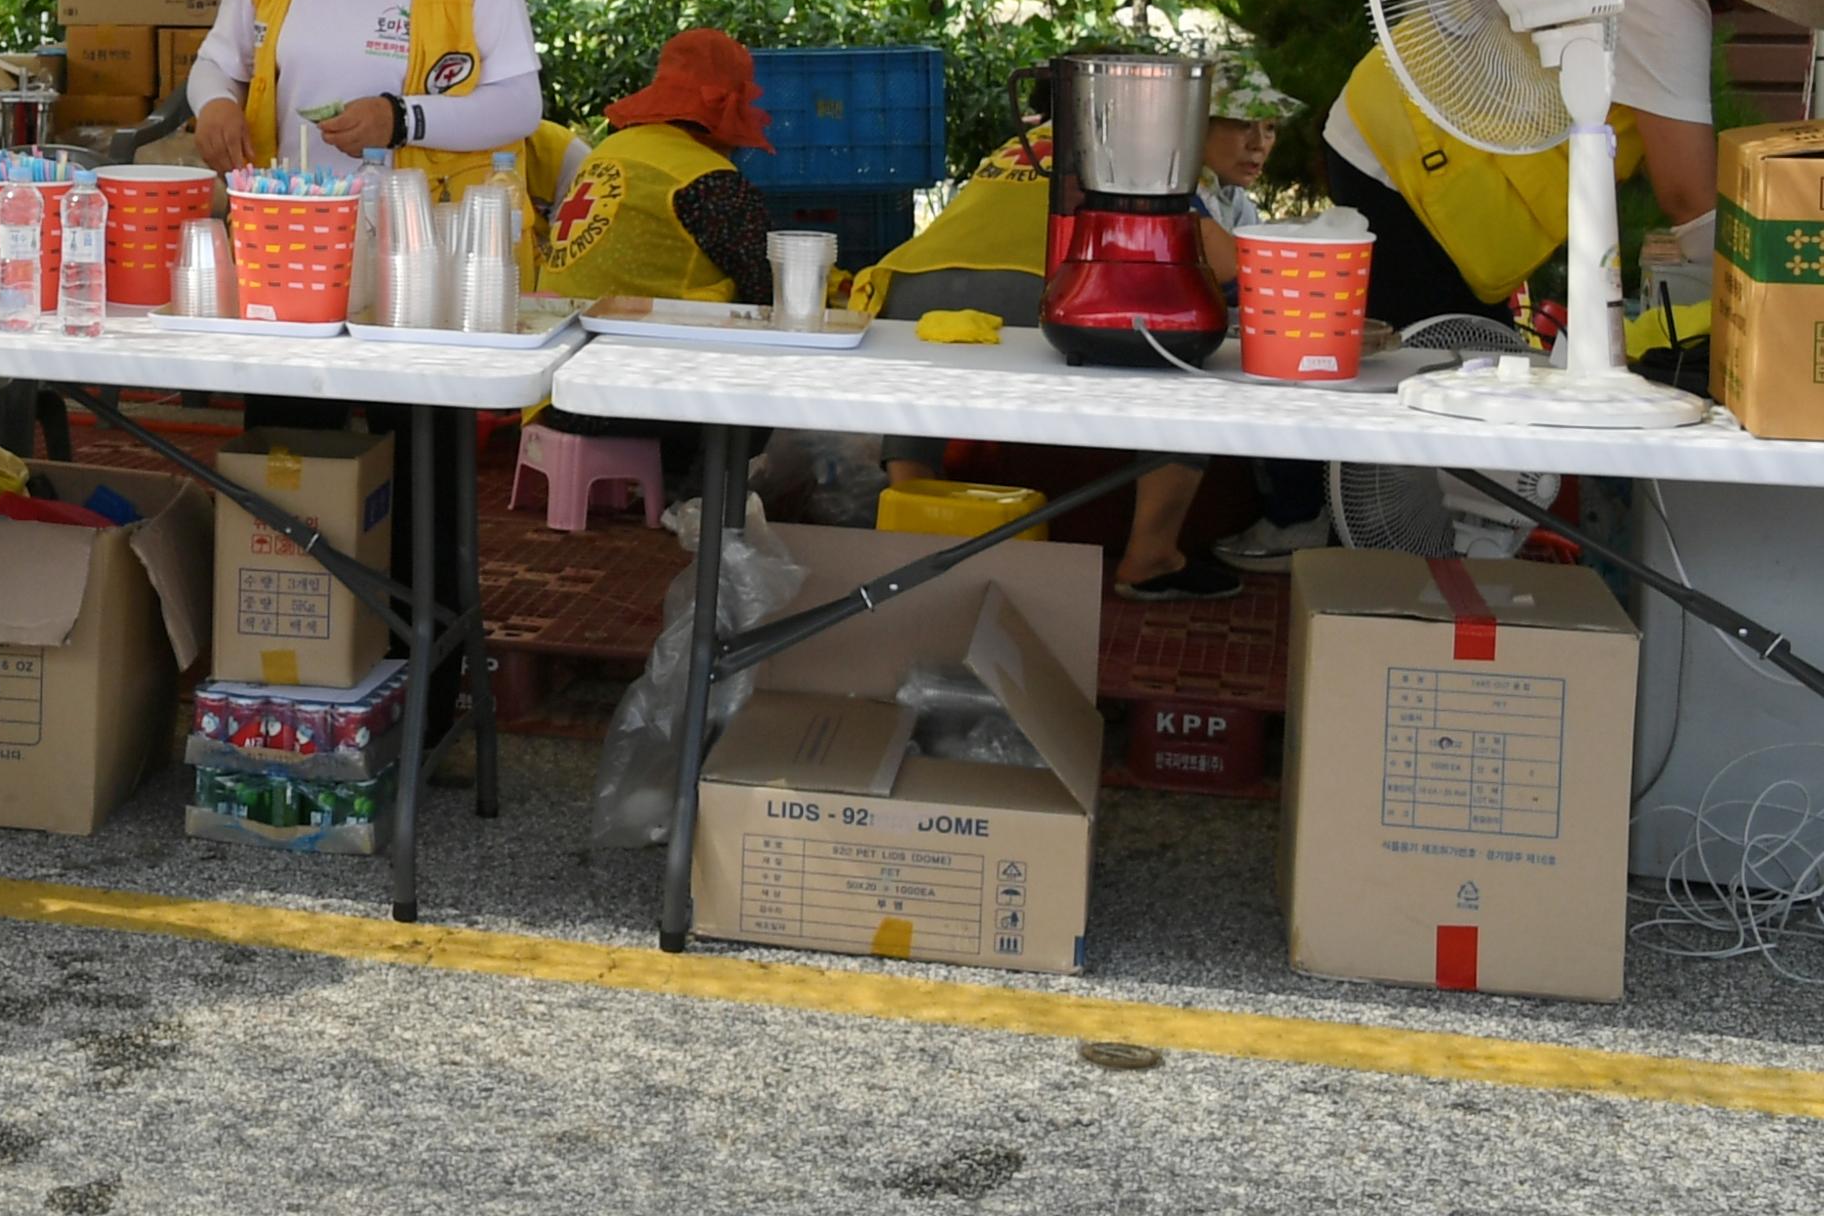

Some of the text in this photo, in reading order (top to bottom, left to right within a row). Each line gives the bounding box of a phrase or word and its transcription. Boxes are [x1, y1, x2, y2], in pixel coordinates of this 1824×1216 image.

[15, 661, 34, 673] OZ
[1156, 712, 1227, 737] KPP
[767, 800, 820, 822] LIDS
[918, 815, 990, 837] DOME
[856, 848, 876, 860] PET
